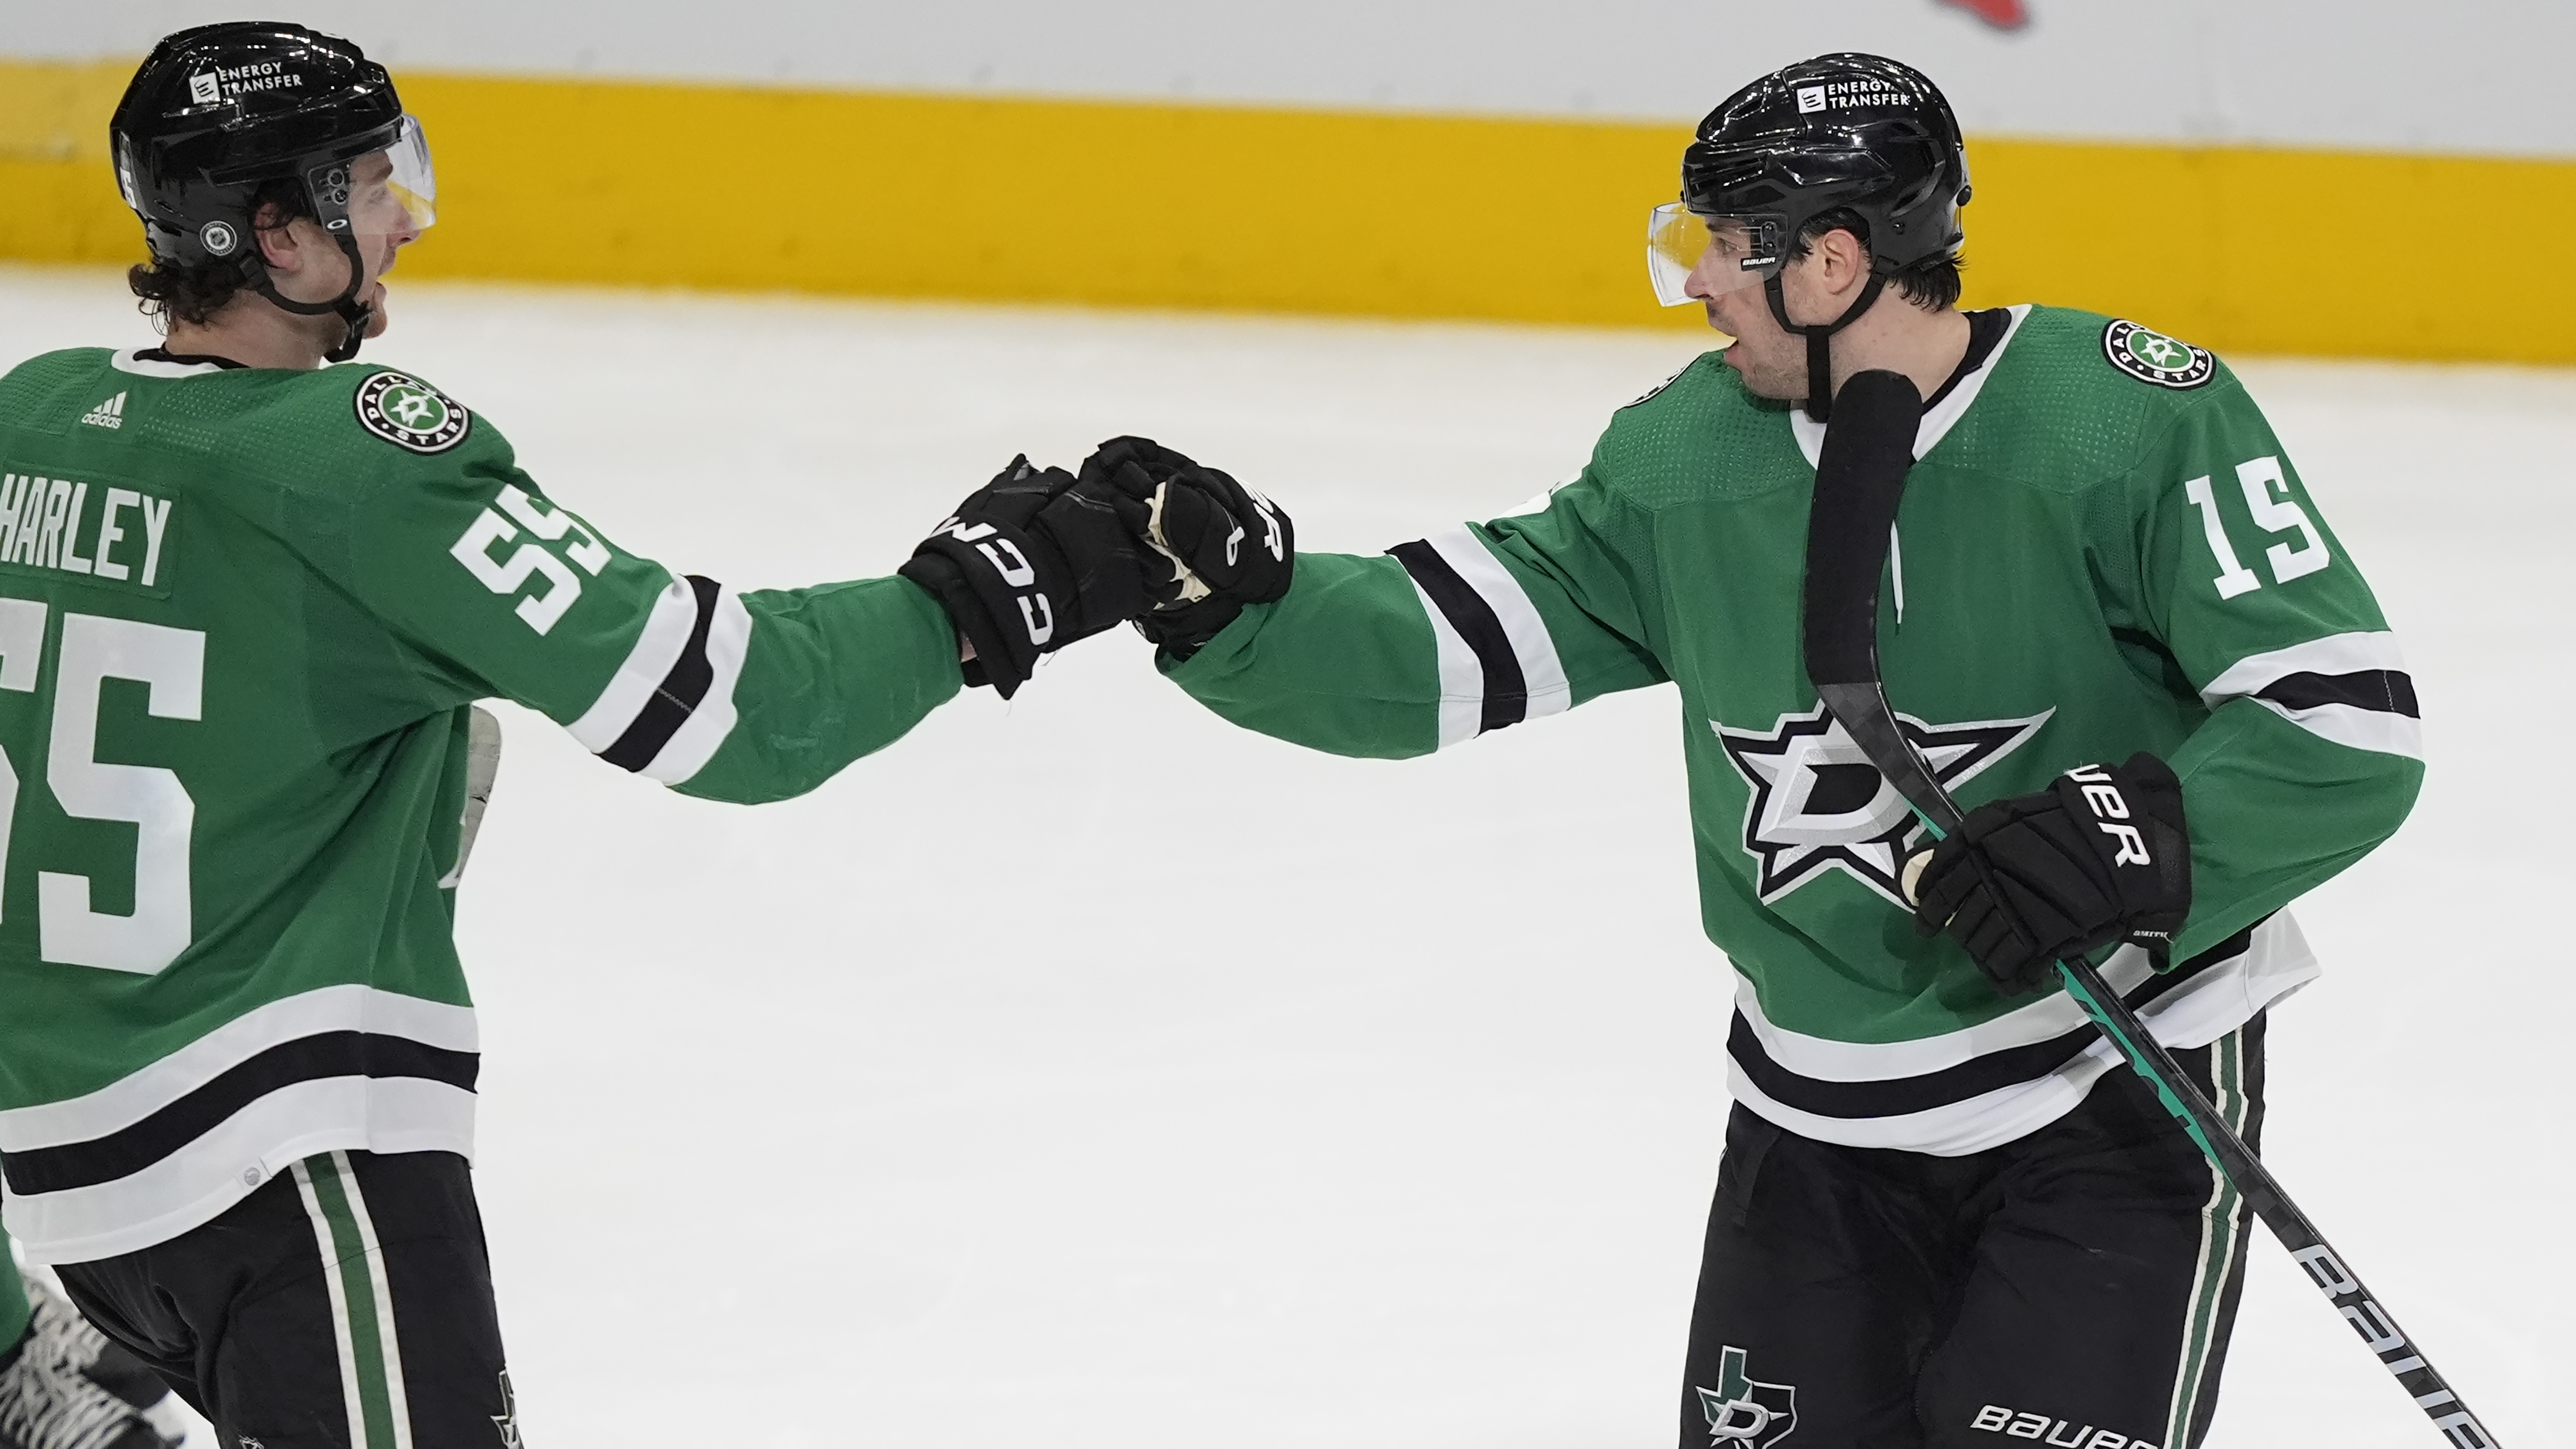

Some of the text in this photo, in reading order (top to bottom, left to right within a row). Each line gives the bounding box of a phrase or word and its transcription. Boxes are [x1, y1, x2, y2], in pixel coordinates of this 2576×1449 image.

[219, 62, 282, 82] ENERGY
[221, 74, 302, 96] TRANSFER
[1828, 80, 1892, 96] ENERGY
[1829, 94, 1911, 109] TRANSFER
[2153, 348, 2207, 381] STARS
[81, 411, 122, 430] adidas
[396, 405, 462, 442] STARS
[0, 473, 172, 586] HARLEY
[2185, 455, 2330, 600] 15
[449, 483, 612, 637] 55
[926, 516, 1053, 646] CCM
[2064, 764, 2151, 868] UER
[2290, 1243, 2501, 1449] BAUE
